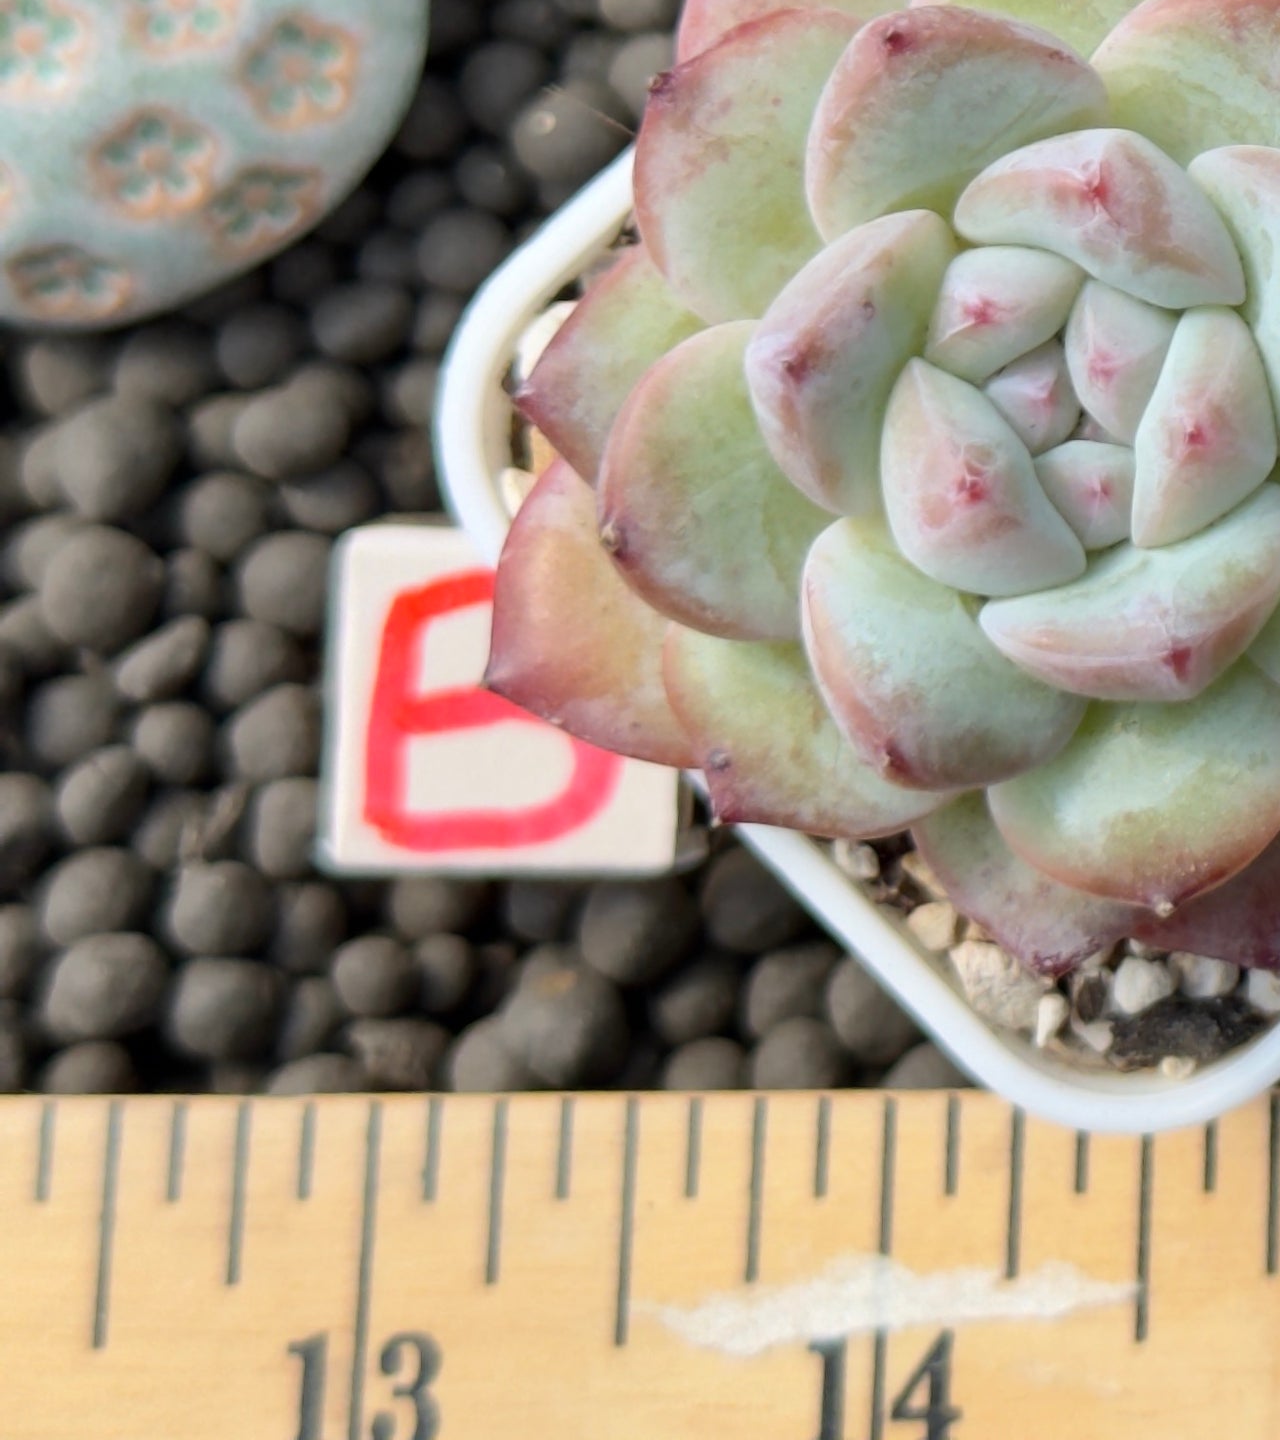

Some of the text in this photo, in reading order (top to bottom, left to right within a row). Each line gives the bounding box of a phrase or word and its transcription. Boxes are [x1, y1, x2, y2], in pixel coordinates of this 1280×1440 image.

[361, 569, 624, 854] B
[286, 1333, 444, 1440] 13
[806, 1328, 961, 1440] 14
